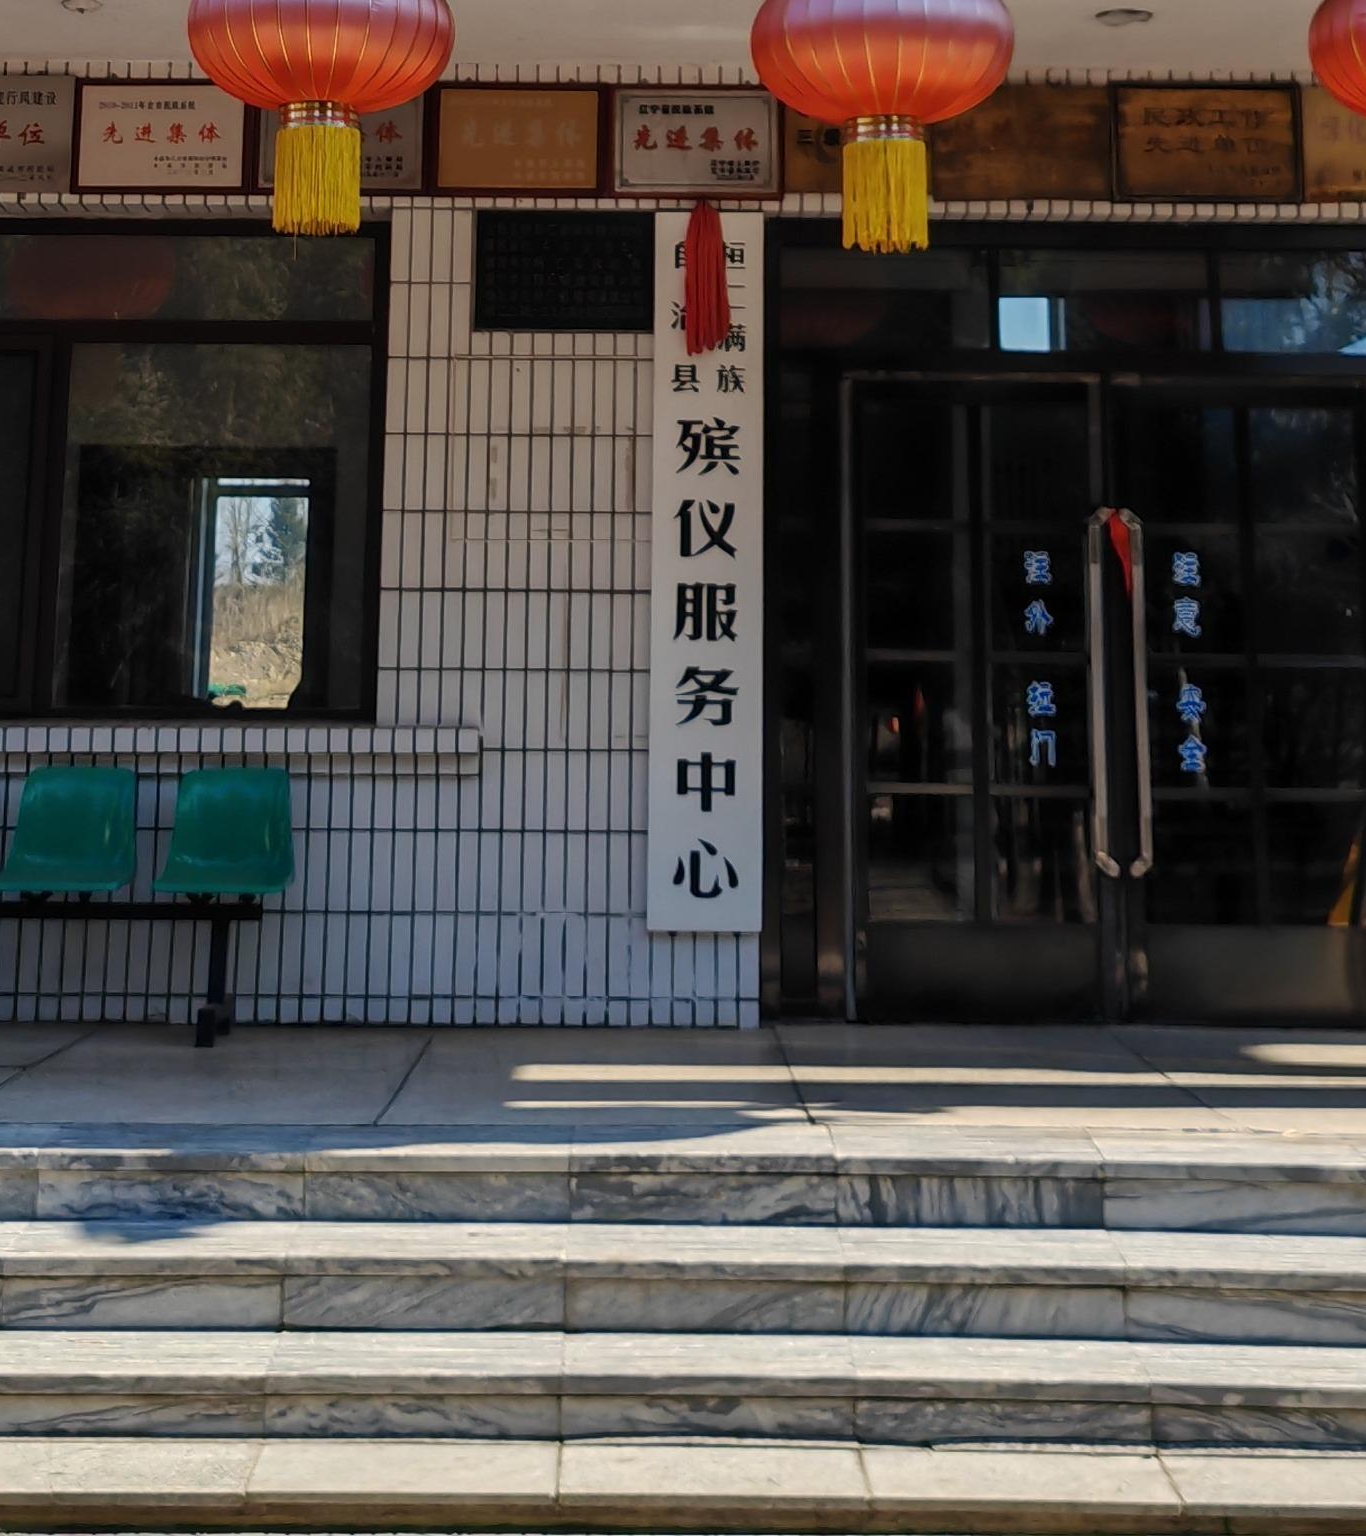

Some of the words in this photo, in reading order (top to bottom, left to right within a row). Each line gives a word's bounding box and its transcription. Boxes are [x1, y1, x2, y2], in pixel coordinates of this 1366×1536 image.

[101, 120, 223, 145] 先进集体
[633, 123, 759, 152] 先进集体
[672, 417, 741, 899] 殡仪服务中心
